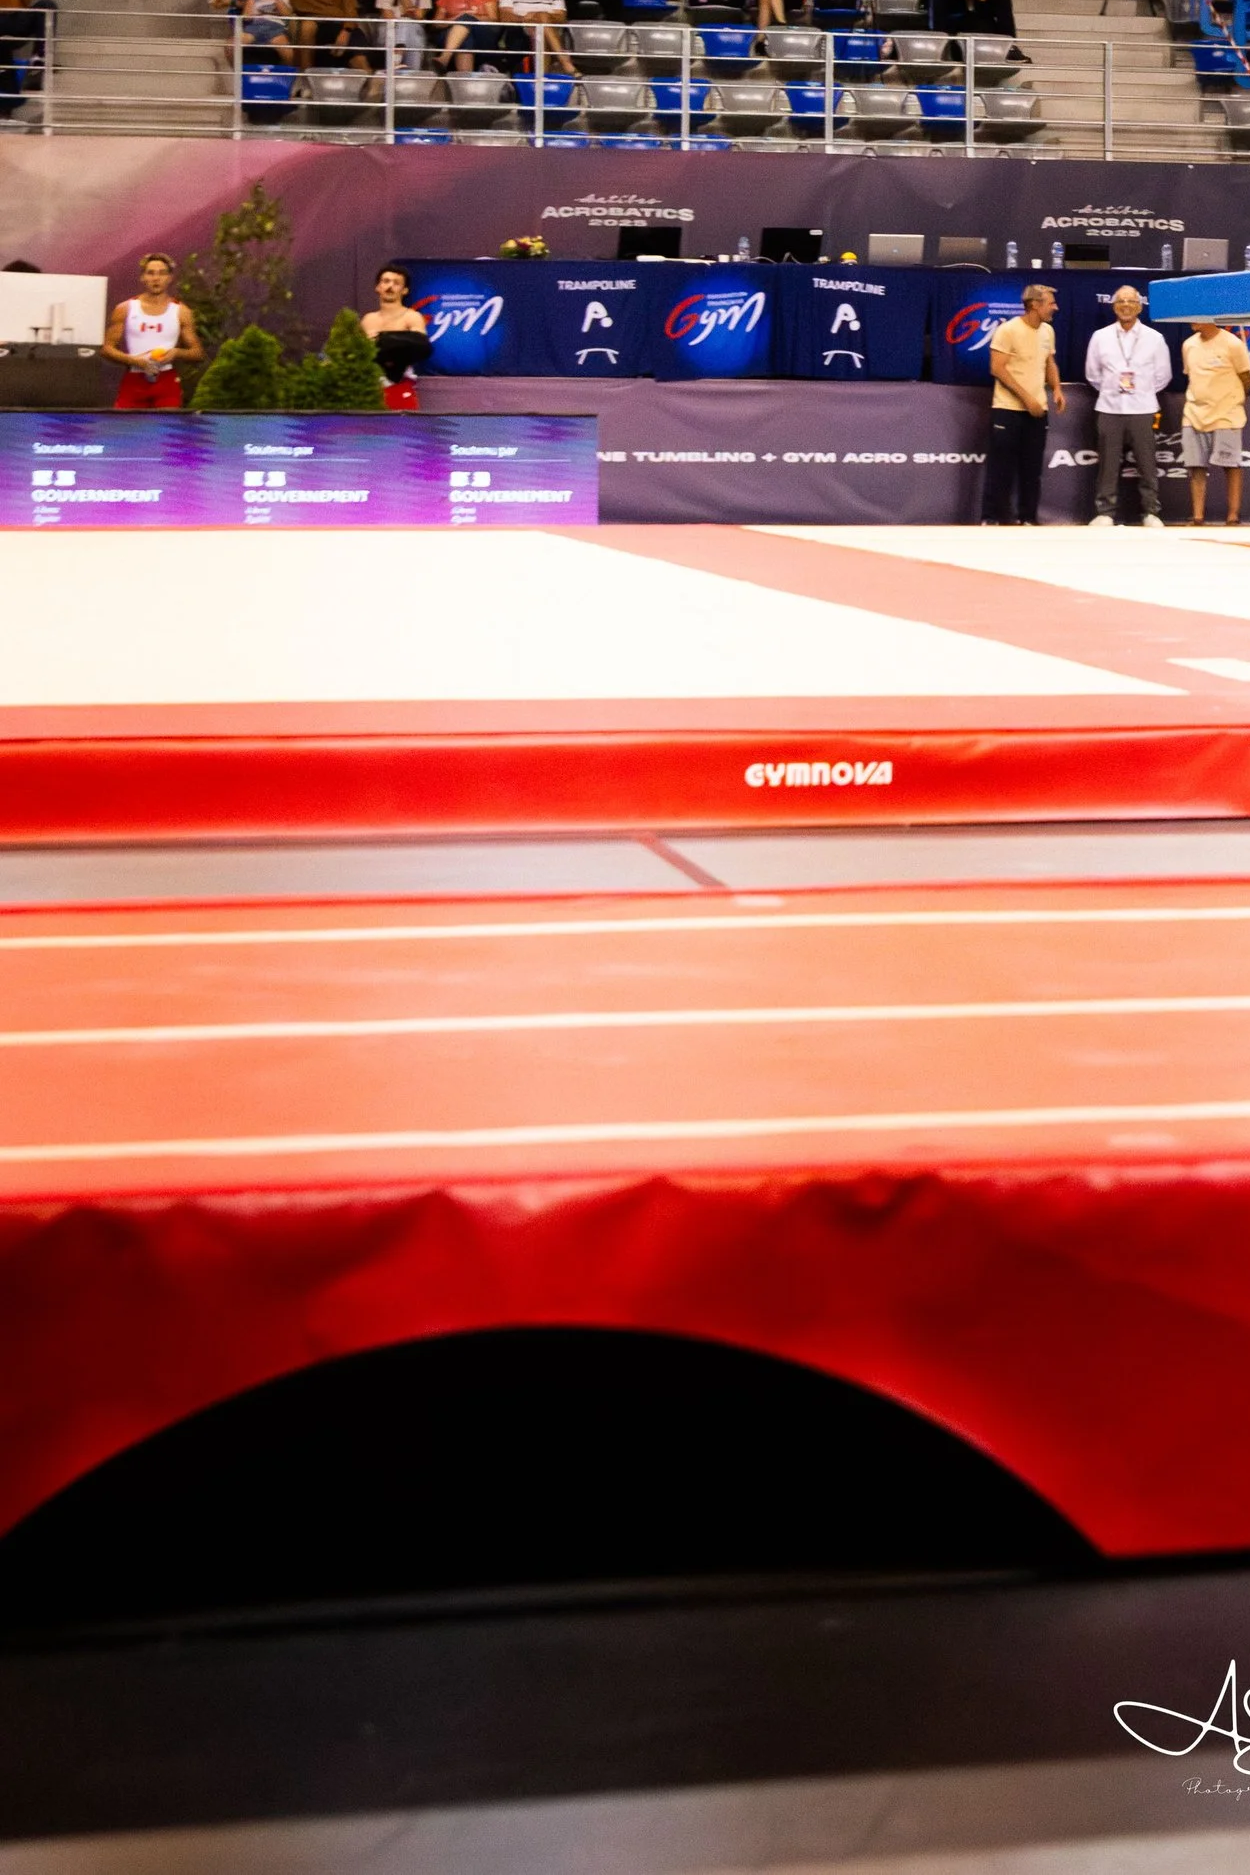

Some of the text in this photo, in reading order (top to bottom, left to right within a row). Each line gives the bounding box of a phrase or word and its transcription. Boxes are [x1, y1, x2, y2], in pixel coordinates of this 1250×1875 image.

[540, 206, 695, 221] ACROBATICS
[588, 219, 648, 227] 2025
[1040, 216, 1186, 232] ACROBATICS
[1085, 229, 1141, 237] 2025
[557, 279, 637, 291] TRAMPOLINE
[812, 277, 886, 296] TRAMPOLINE
[664, 291, 766, 346] Gym
[632, 451, 757, 463] TUMBLING
[783, 452, 836, 463] GYM
[843, 452, 908, 463] ACRO
[913, 453, 987, 464] SHOW
[31, 489, 163, 502] GOUVERNEMENT
[243, 490, 370, 503] GOUVERNEMENT
[450, 490, 573, 502] GOUVERNEMENT
[744, 760, 893, 788] GYMNOVA
